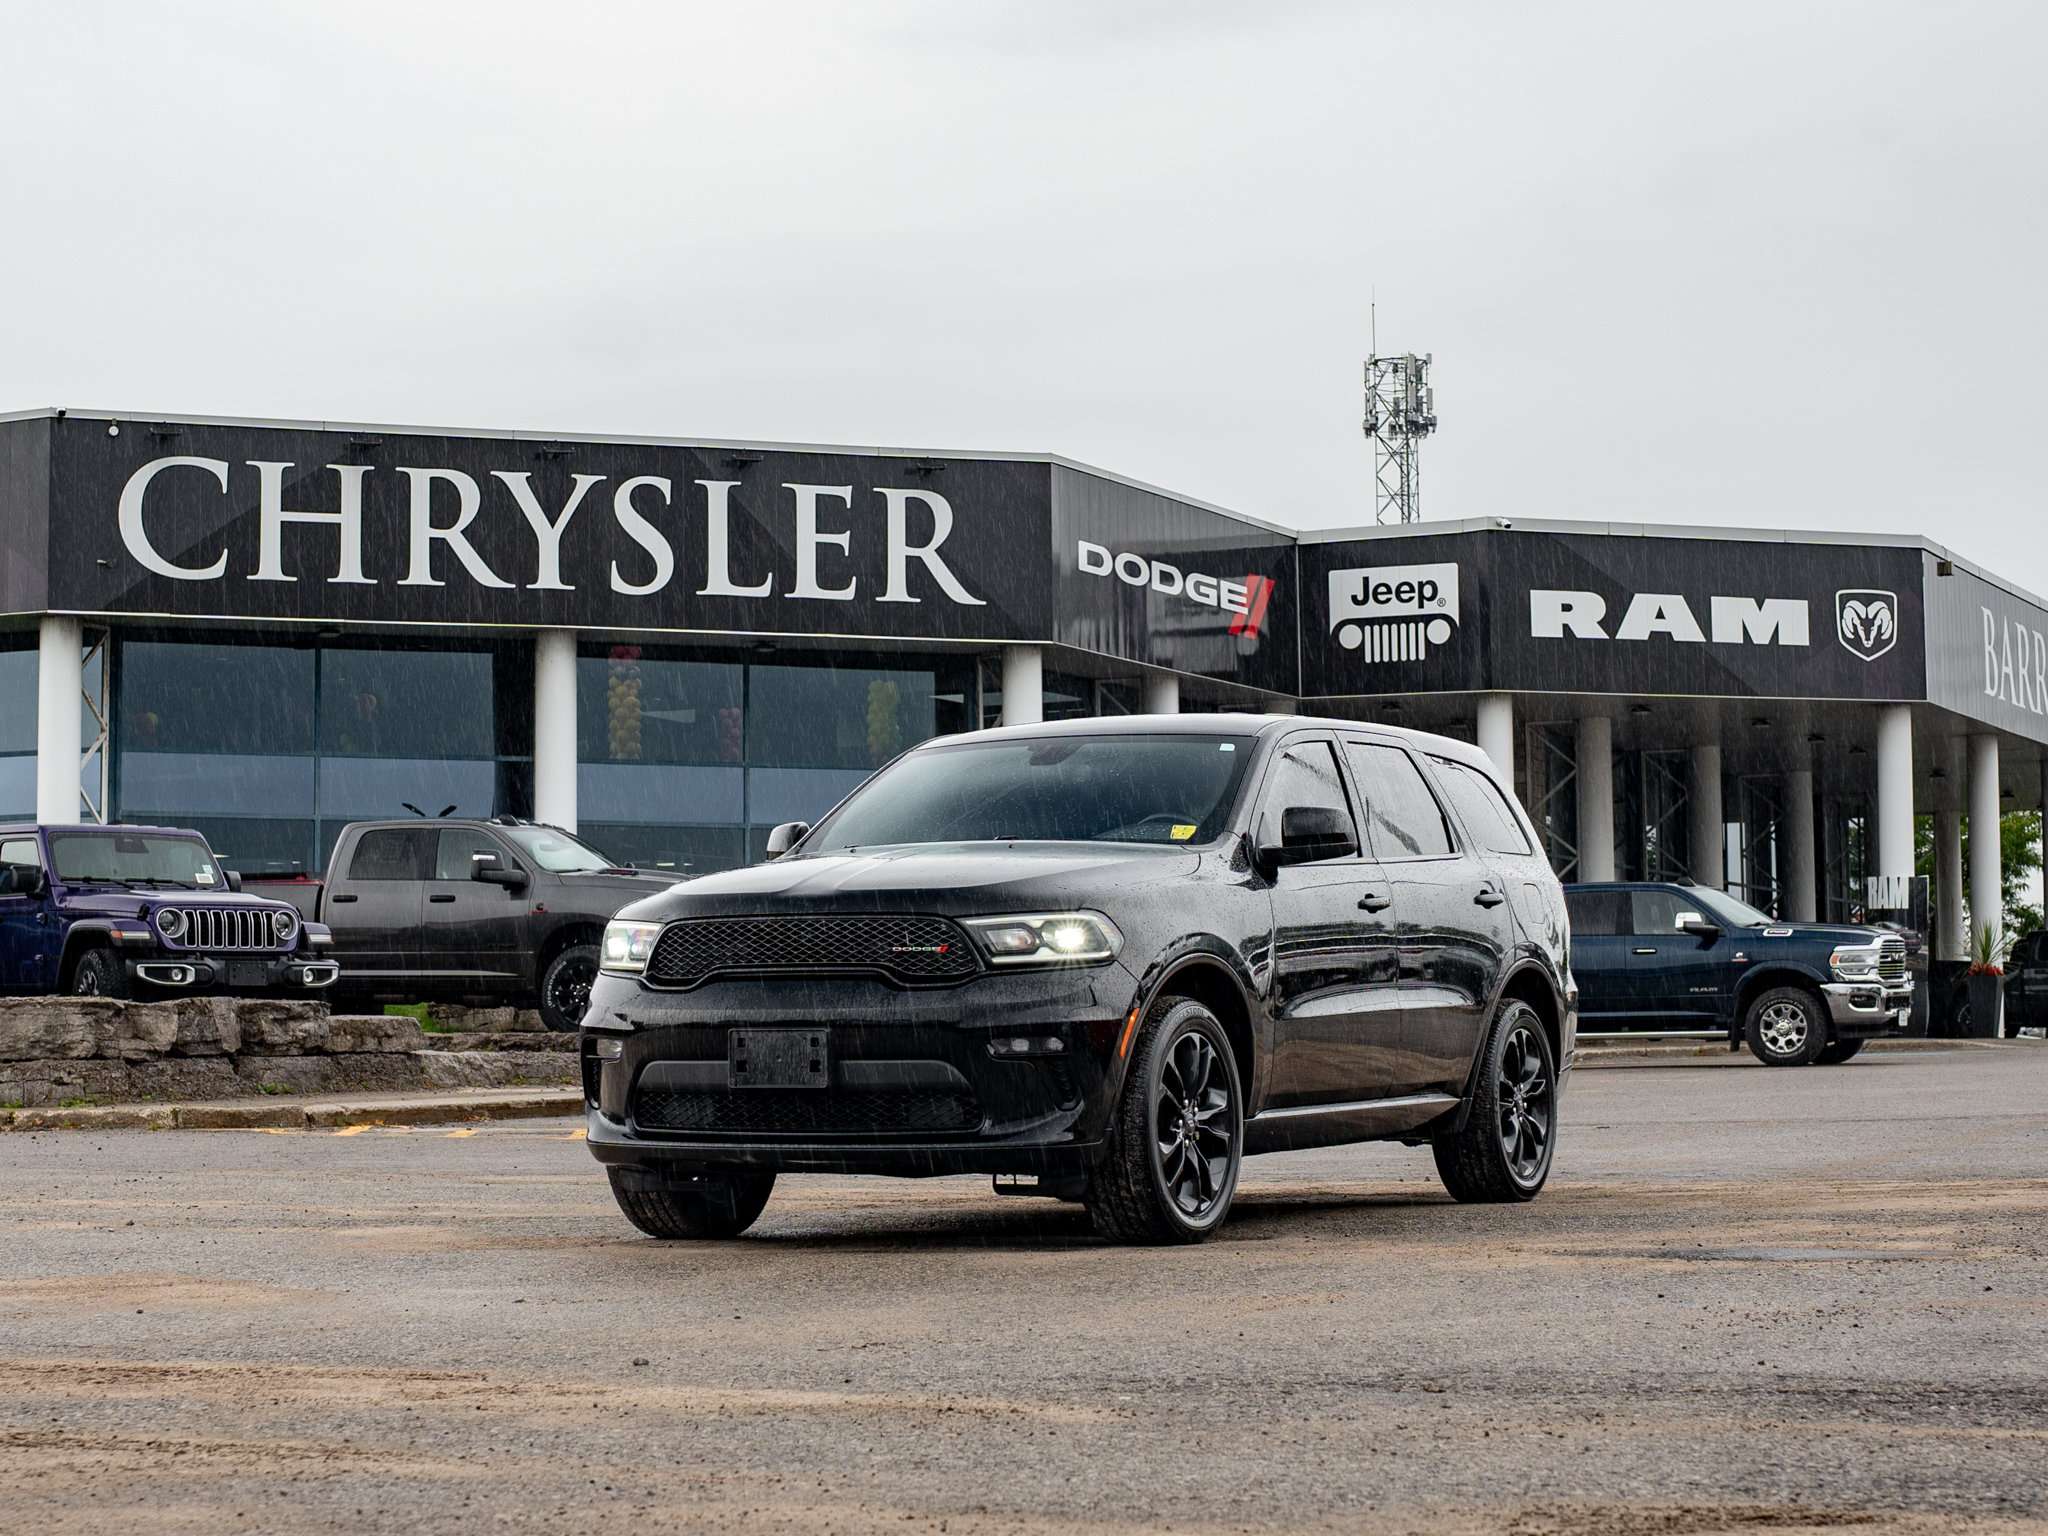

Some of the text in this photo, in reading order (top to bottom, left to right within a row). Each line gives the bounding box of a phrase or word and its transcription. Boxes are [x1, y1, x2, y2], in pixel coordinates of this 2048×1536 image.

[119, 457, 987, 605] CHRYSLER
[1078, 541, 1249, 615] DODGE
[1350, 575, 1439, 609] Jeep
[1530, 590, 1810, 646] RAM
[1868, 876, 1910, 909] RAM
